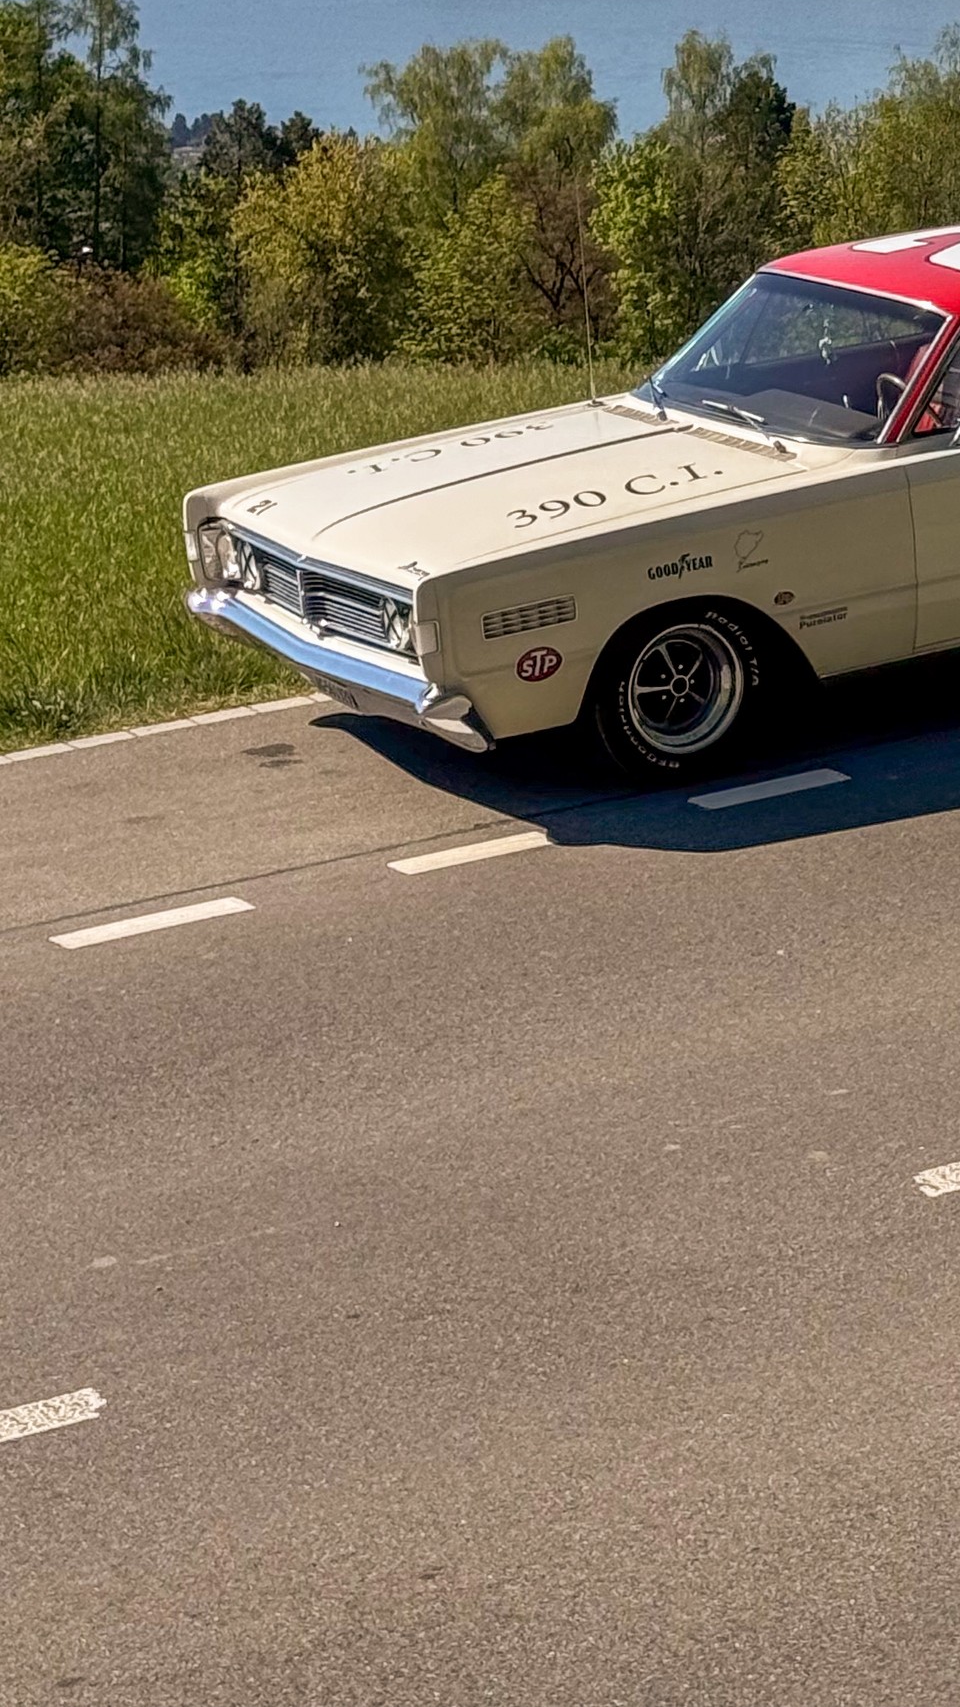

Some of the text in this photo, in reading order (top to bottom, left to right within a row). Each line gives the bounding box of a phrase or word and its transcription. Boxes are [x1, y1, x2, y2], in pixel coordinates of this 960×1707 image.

[506, 462, 724, 529] 390 C.I.
[647, 552, 713, 580] GOODYEAR
[520, 649, 558, 678] STP
[705, 610, 760, 686] Radial T/A
